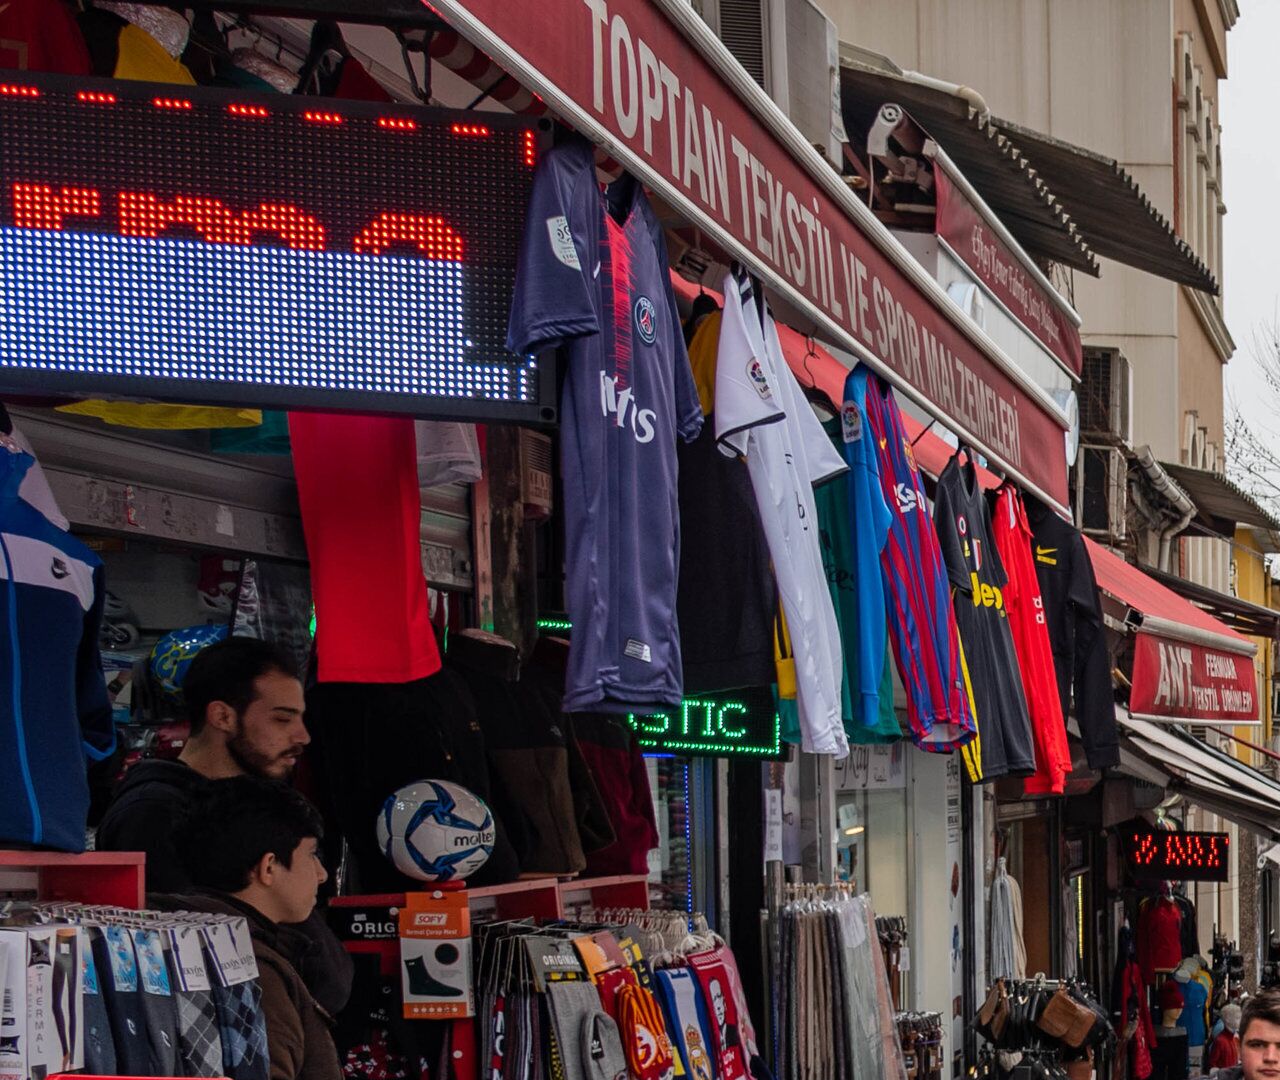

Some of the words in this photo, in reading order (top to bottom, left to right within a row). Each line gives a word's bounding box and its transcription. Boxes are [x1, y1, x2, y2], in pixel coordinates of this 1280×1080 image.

[584, 0, 732, 226] TOPTAN
[731, 134, 842, 320] TEKSTİL
[840, 257, 873, 339] VE
[873, 276, 921, 377] SPOR
[922, 336, 1022, 467] MALZEMELERİ
[1154, 642, 1194, 709] ANT
[35, 973, 45, 1054] THERMAL
